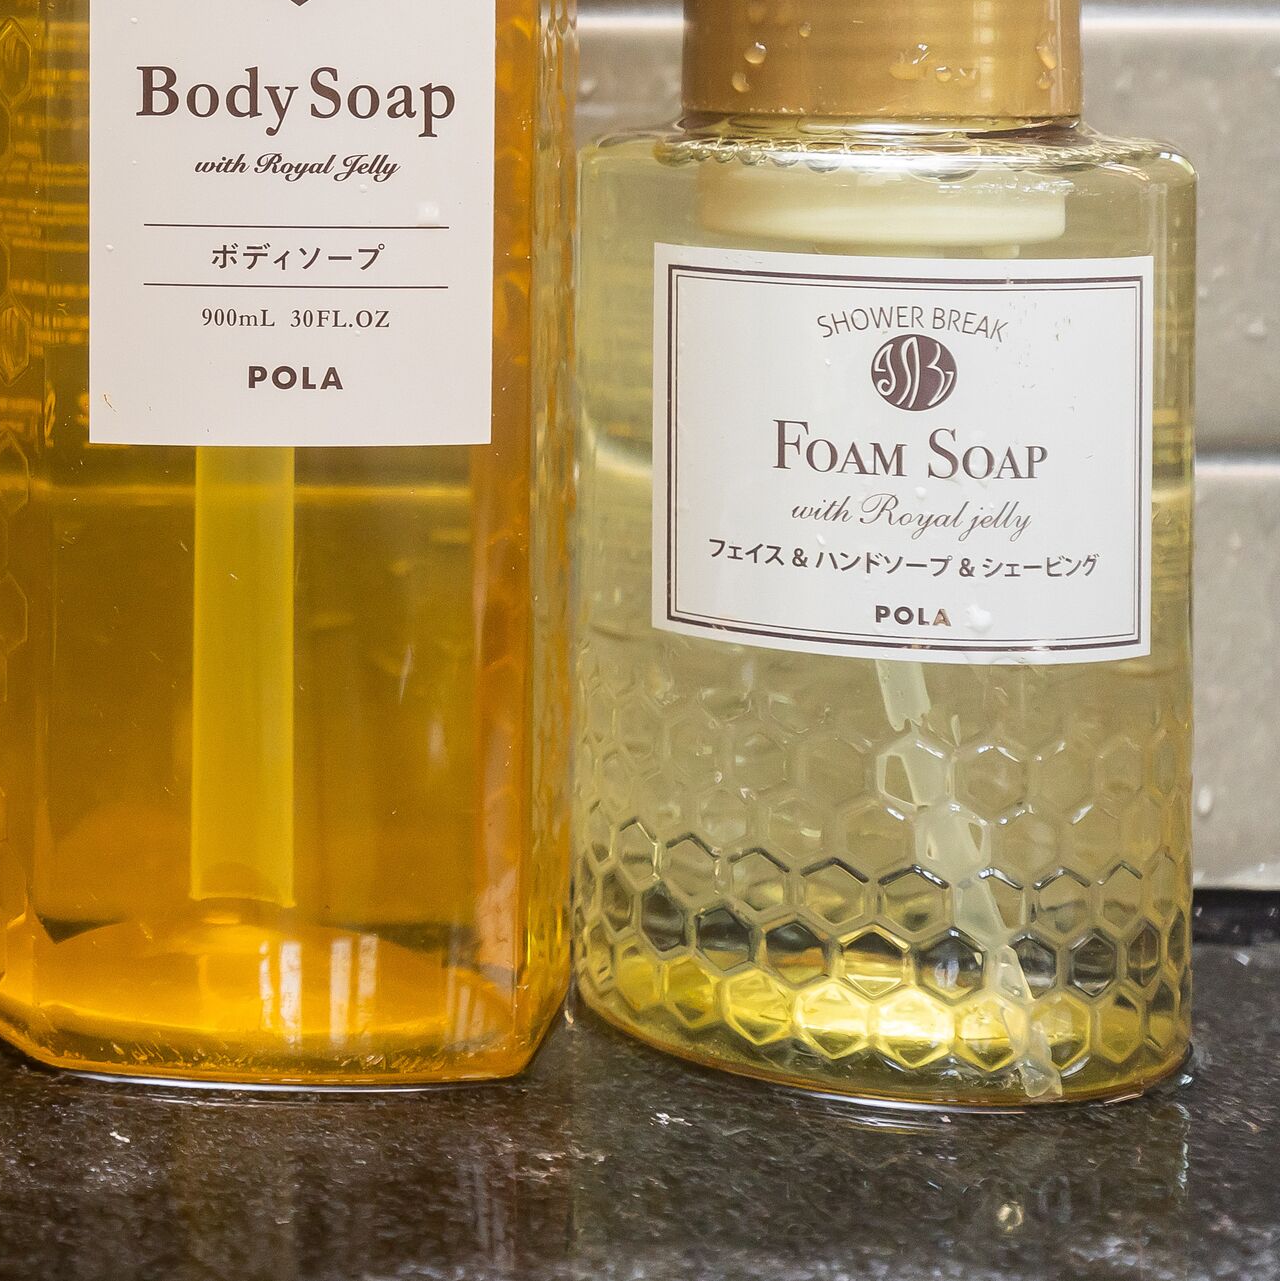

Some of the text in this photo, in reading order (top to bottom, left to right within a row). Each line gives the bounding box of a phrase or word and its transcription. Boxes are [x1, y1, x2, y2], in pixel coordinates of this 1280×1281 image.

[135, 65, 456, 138] Body Soap
[194, 152, 401, 183] with Royal Jelly
[211, 242, 386, 271] ボディソープ
[201, 308, 390, 328] 900mL 30FL.OZ
[816, 305, 1009, 343] SHOWER BREAK
[248, 365, 344, 390] POLA
[791, 493, 1031, 542] with Royal jelly
[708, 538, 1100, 578] フェイス & ハンドソープ & シェービング
[875, 604, 952, 627] POLA
